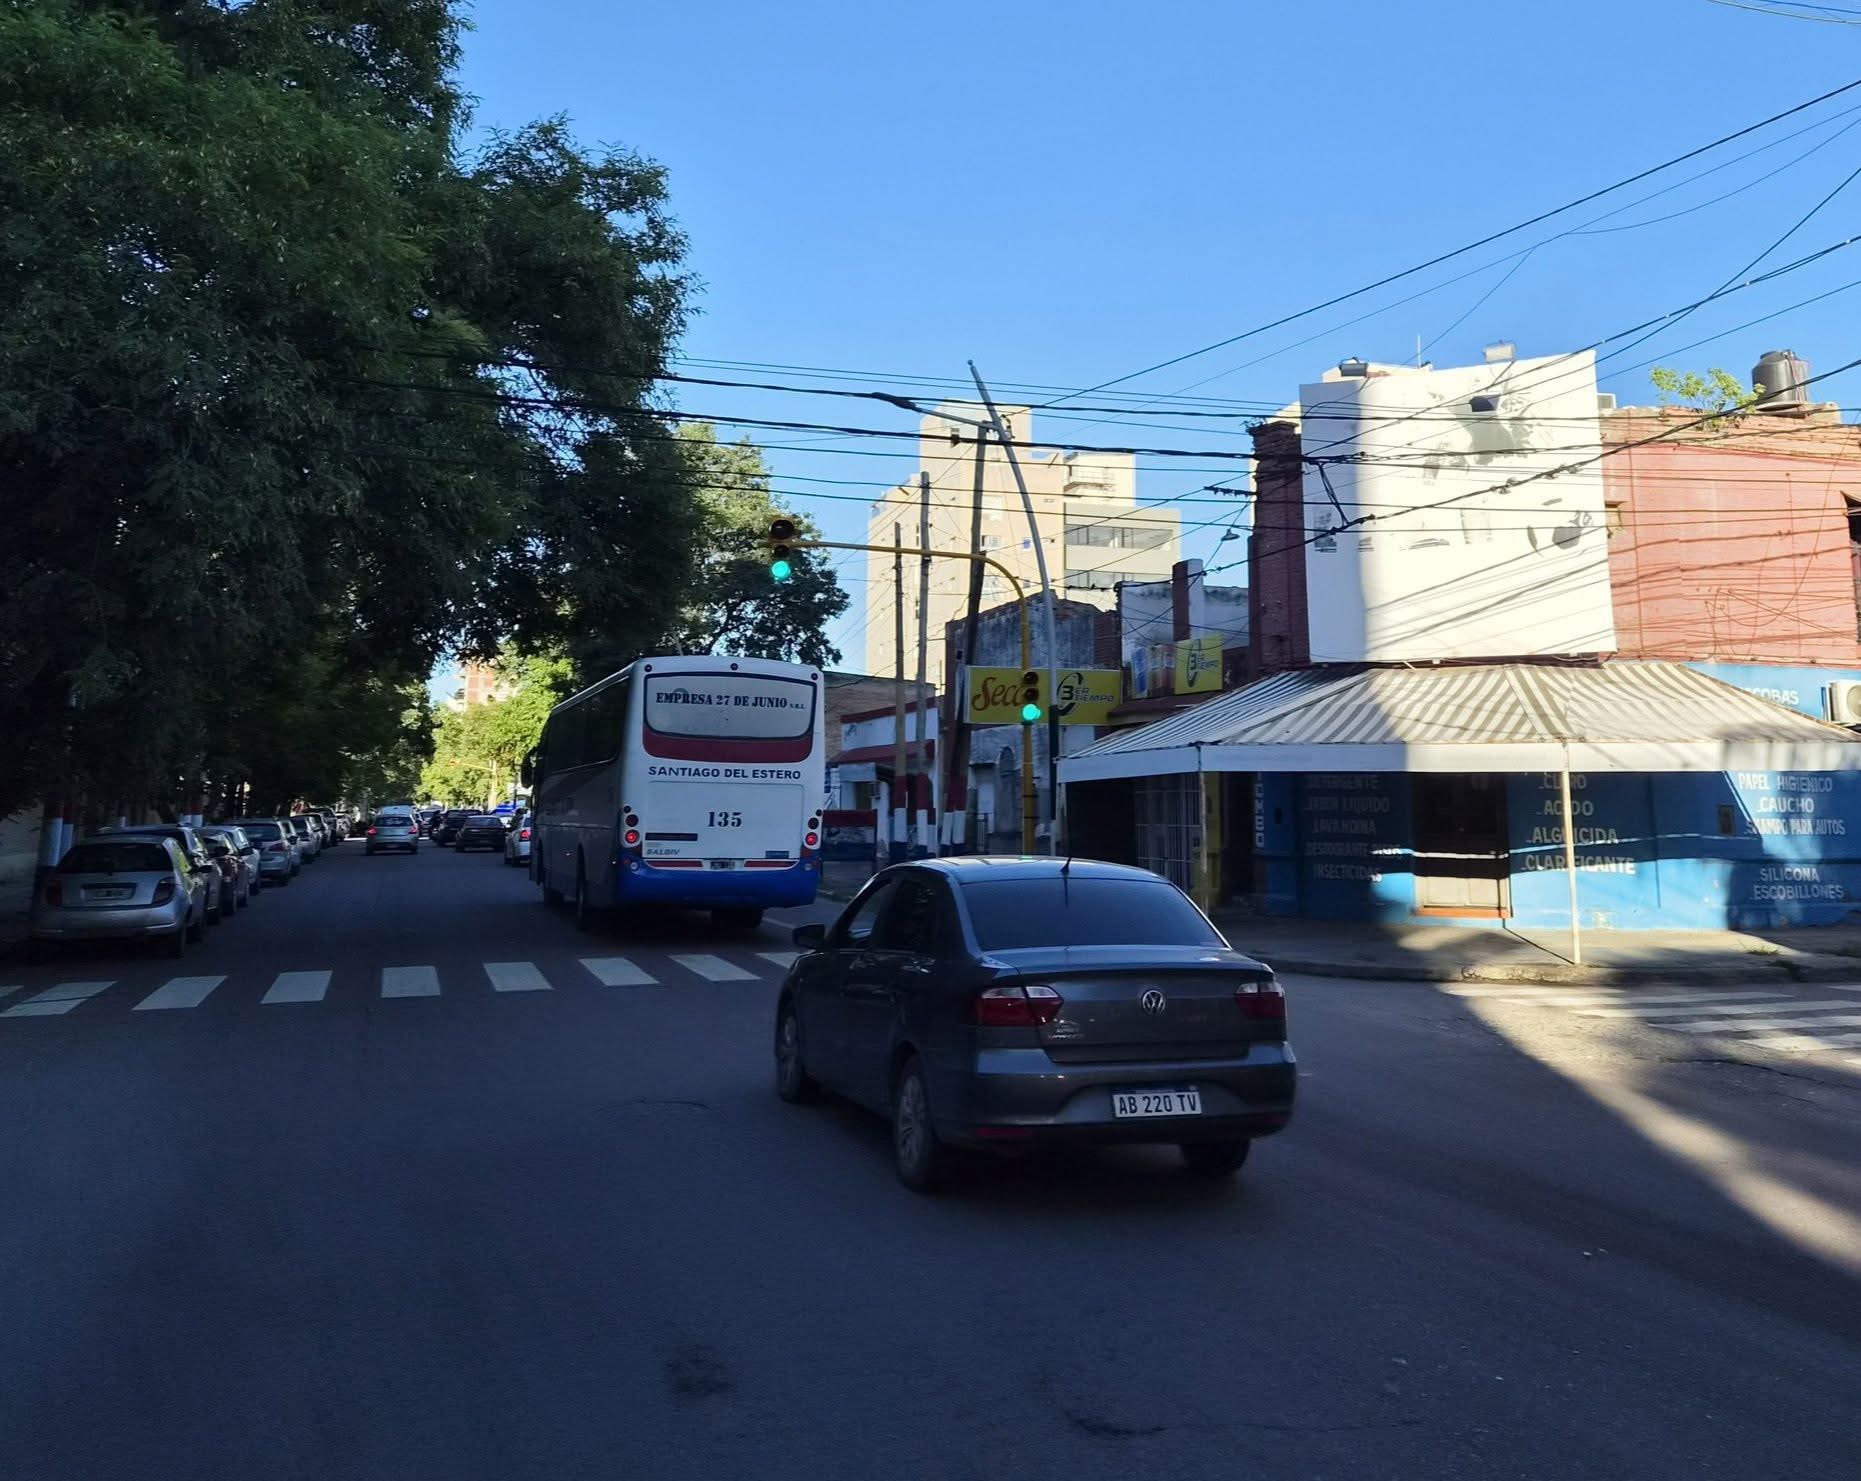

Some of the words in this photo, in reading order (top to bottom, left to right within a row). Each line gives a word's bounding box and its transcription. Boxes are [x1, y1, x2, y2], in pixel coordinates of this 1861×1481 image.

[655, 692, 713, 705] EMPRESA
[716, 695, 731, 706] 27
[734, 695, 750, 707] DE
[752, 696, 788, 708] JUNIO
[1074, 694, 1114, 702] TIEMPO
[648, 766, 720, 778] SANTIAGO
[724, 768, 749, 778] DEL
[752, 769, 801, 780] ESTERO
[1738, 773, 1769, 790] PAPEL
[1777, 775, 1833, 792] HIGIENICO
[1759, 797, 1815, 813] CAUCHO
[707, 811, 742, 828] 135
[1815, 819, 1846, 835] AUTOS
[1533, 827, 1619, 844] ALGICIDA
[1525, 854, 1636, 874] CLARFICANTE
[1759, 867, 1820, 882] SILICONA
[1753, 884, 1844, 901] ESCOBILLONES
[1119, 1095, 1138, 1115] AB
[1142, 1094, 1173, 1113] 220
[1177, 1093, 1196, 1111] TV
